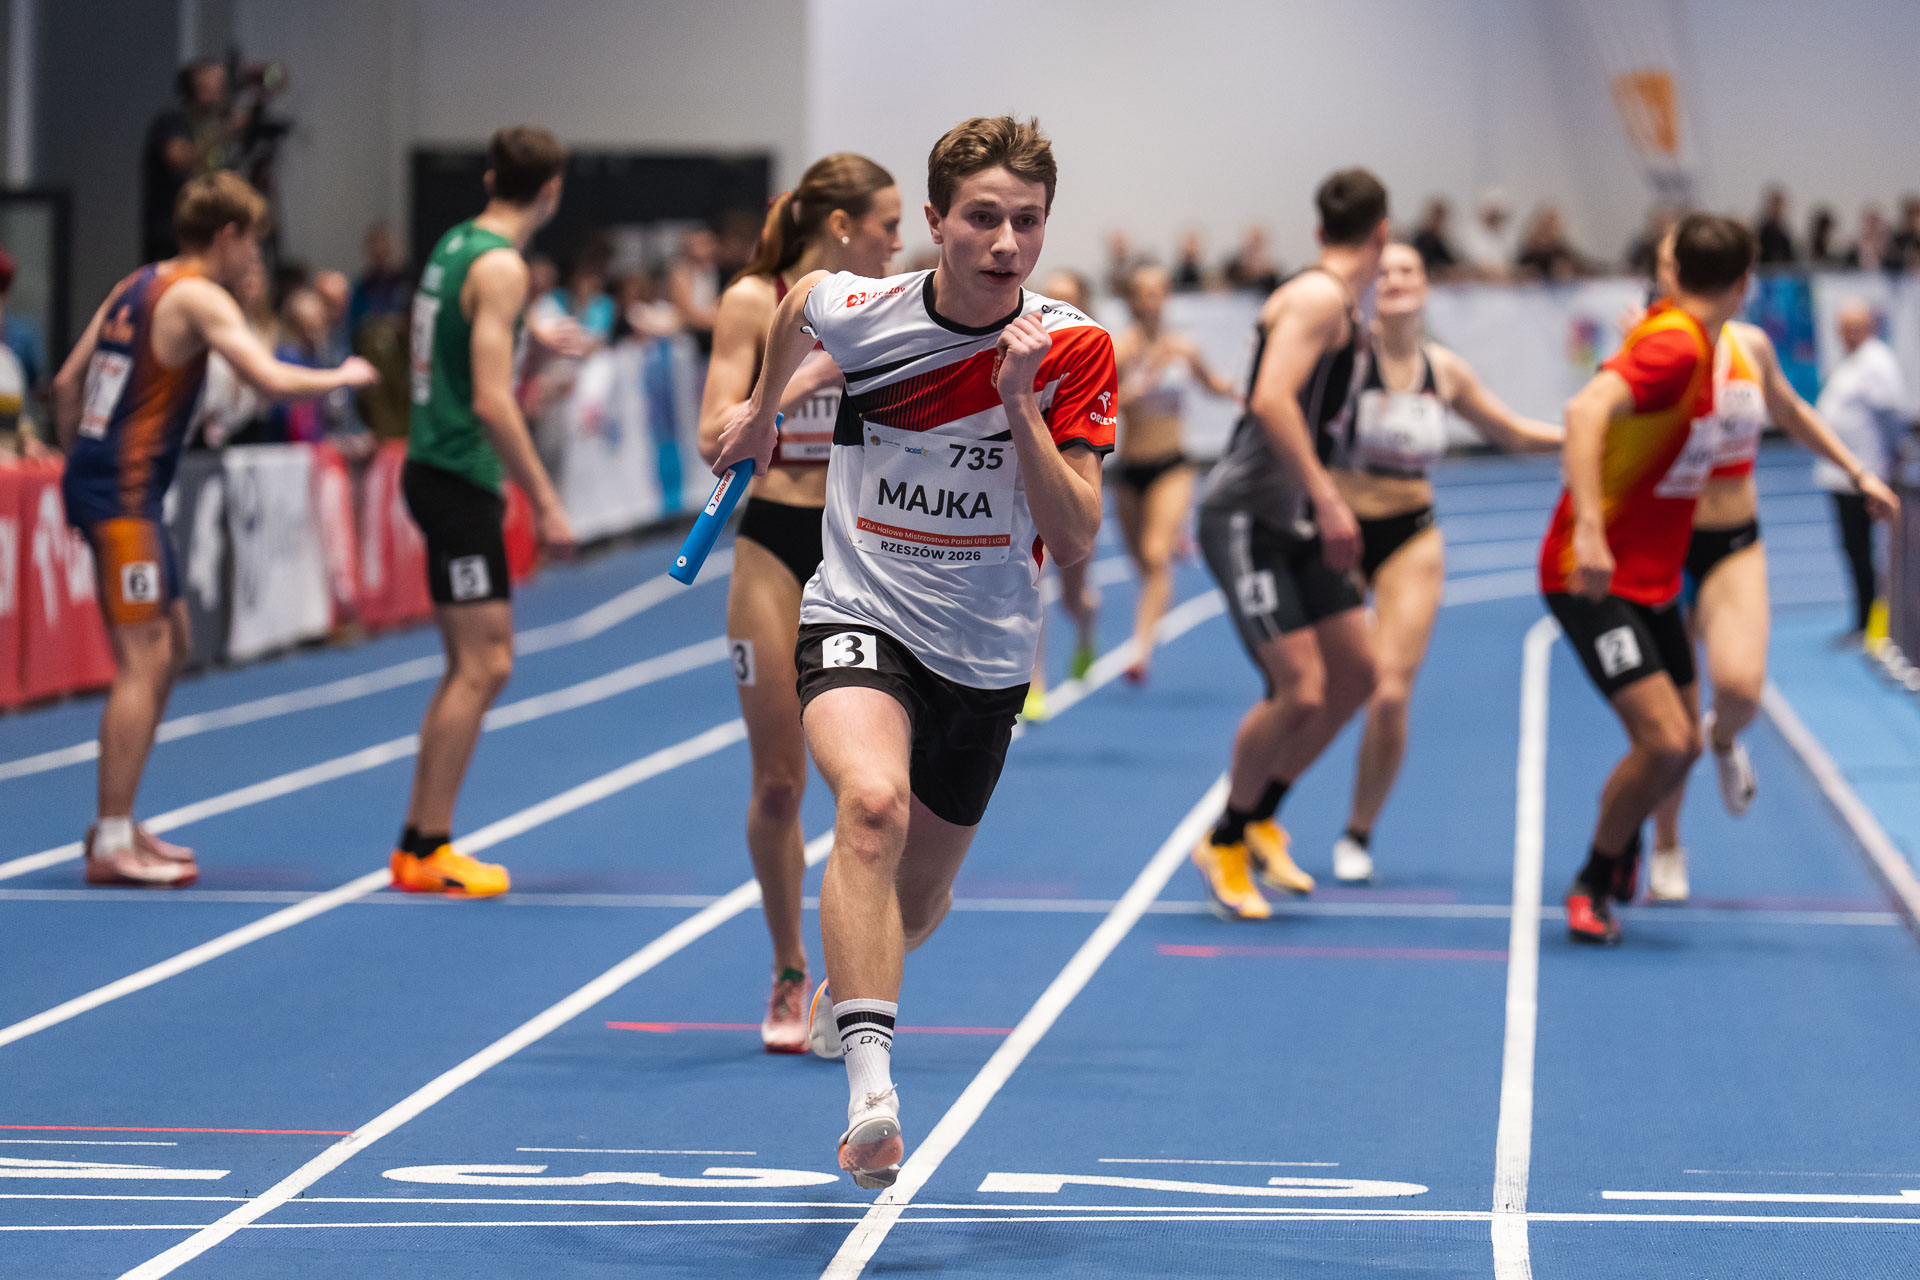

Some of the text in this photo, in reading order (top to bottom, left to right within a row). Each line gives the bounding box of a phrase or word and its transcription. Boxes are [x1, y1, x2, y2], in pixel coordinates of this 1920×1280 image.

[1090, 411, 1117, 426] ORLEN
[949, 443, 1004, 471] 735
[714, 471, 733, 503] polanik
[877, 477, 993, 519] MAJKA
[861, 521, 876, 531] PZLA
[877, 525, 903, 538] Halowe
[904, 531, 950, 545] Mistrzostwa
[951, 537, 973, 545] Polski
[992, 537, 1007, 545] U20
[880, 540, 981, 561] RZESZÓW 2026
[129, 565, 149, 600] 6
[733, 644, 748, 680] 3
[834, 635, 865, 667] 3
